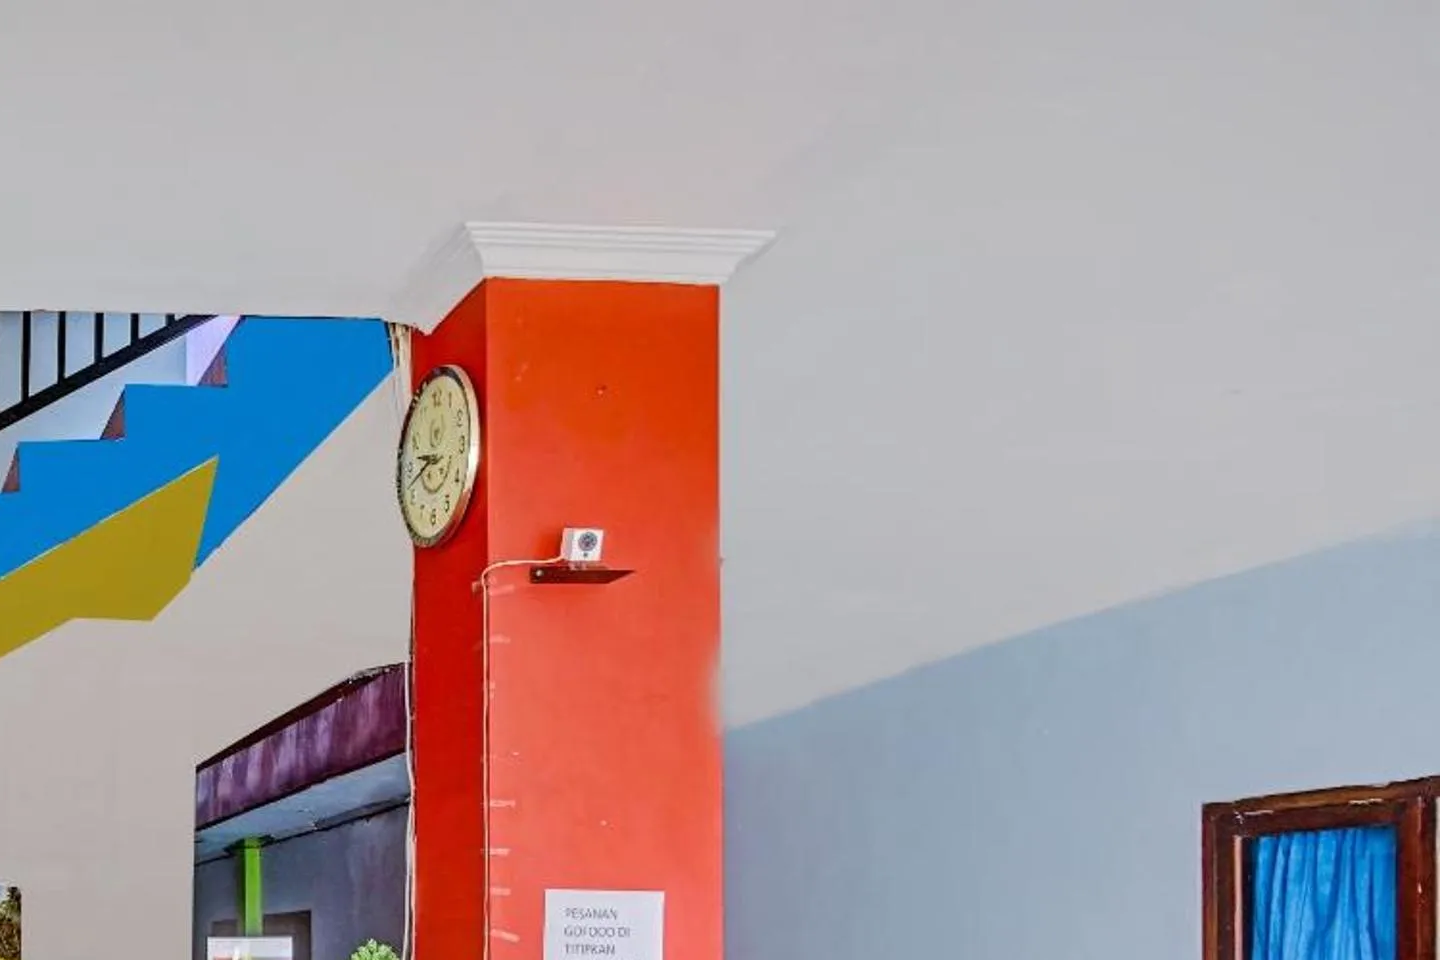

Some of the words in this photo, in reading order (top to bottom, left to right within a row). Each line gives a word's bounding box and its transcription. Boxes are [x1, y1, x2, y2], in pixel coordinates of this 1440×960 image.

[564, 907, 618, 920] PESANAN
[563, 925, 615, 938] GOFOOD
[617, 926, 631, 938] DI
[564, 943, 616, 956] TITIPKAN
